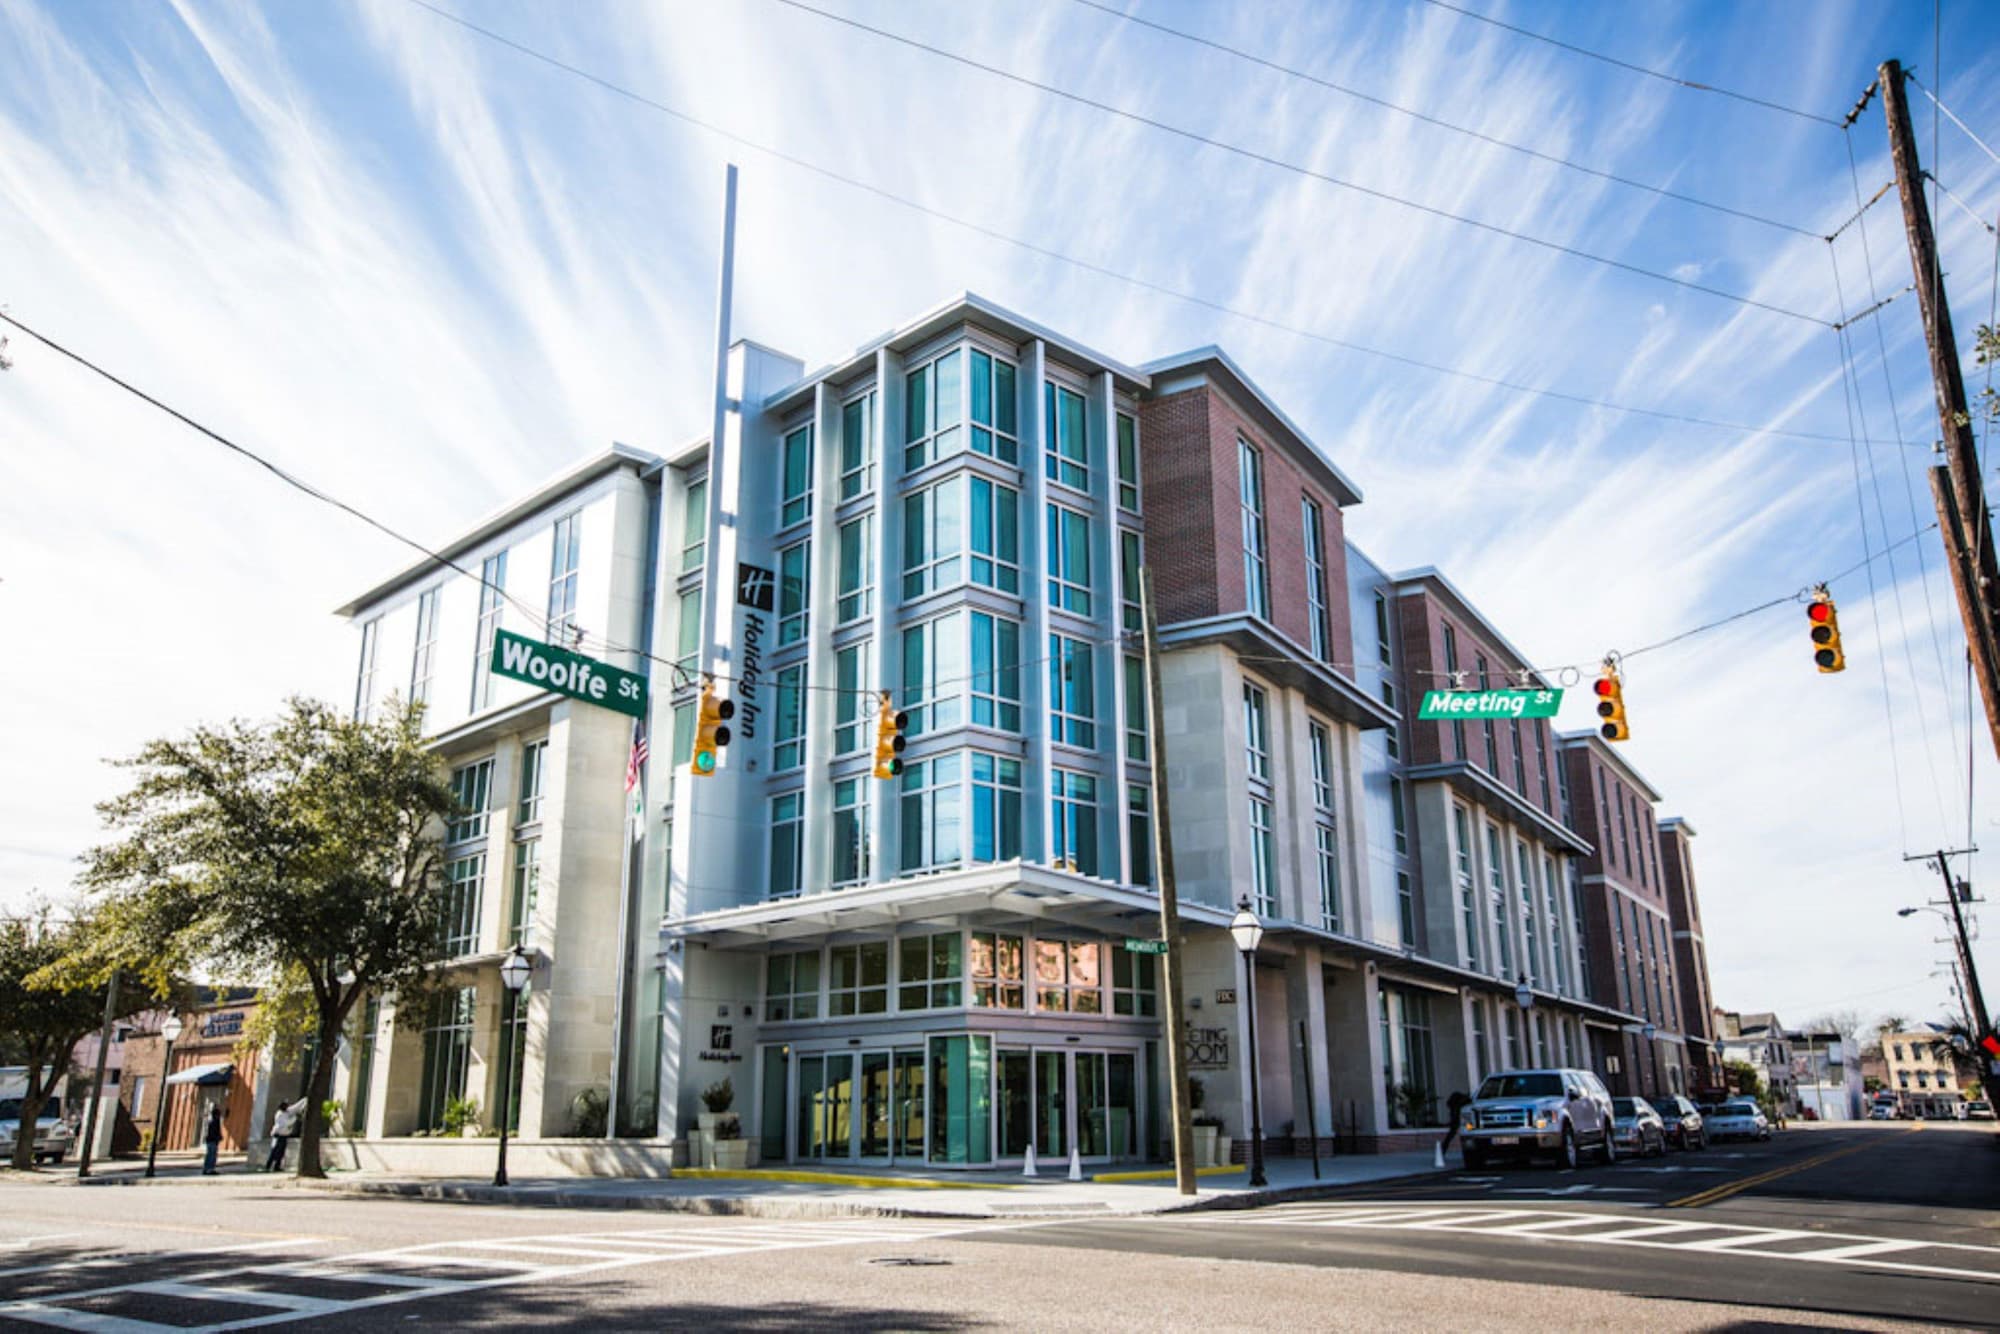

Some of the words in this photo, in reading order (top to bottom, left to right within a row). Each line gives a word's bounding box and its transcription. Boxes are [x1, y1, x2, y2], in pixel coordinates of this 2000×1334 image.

[502, 638, 607, 699] Woolfe
[618, 677, 640, 700] St
[738, 613, 764, 699] Holiday
[741, 702, 761, 738] Inn
[1428, 692, 1526, 717] Meeting
[1534, 691, 1555, 704] St
[1184, 1043, 1228, 1065] OOM
